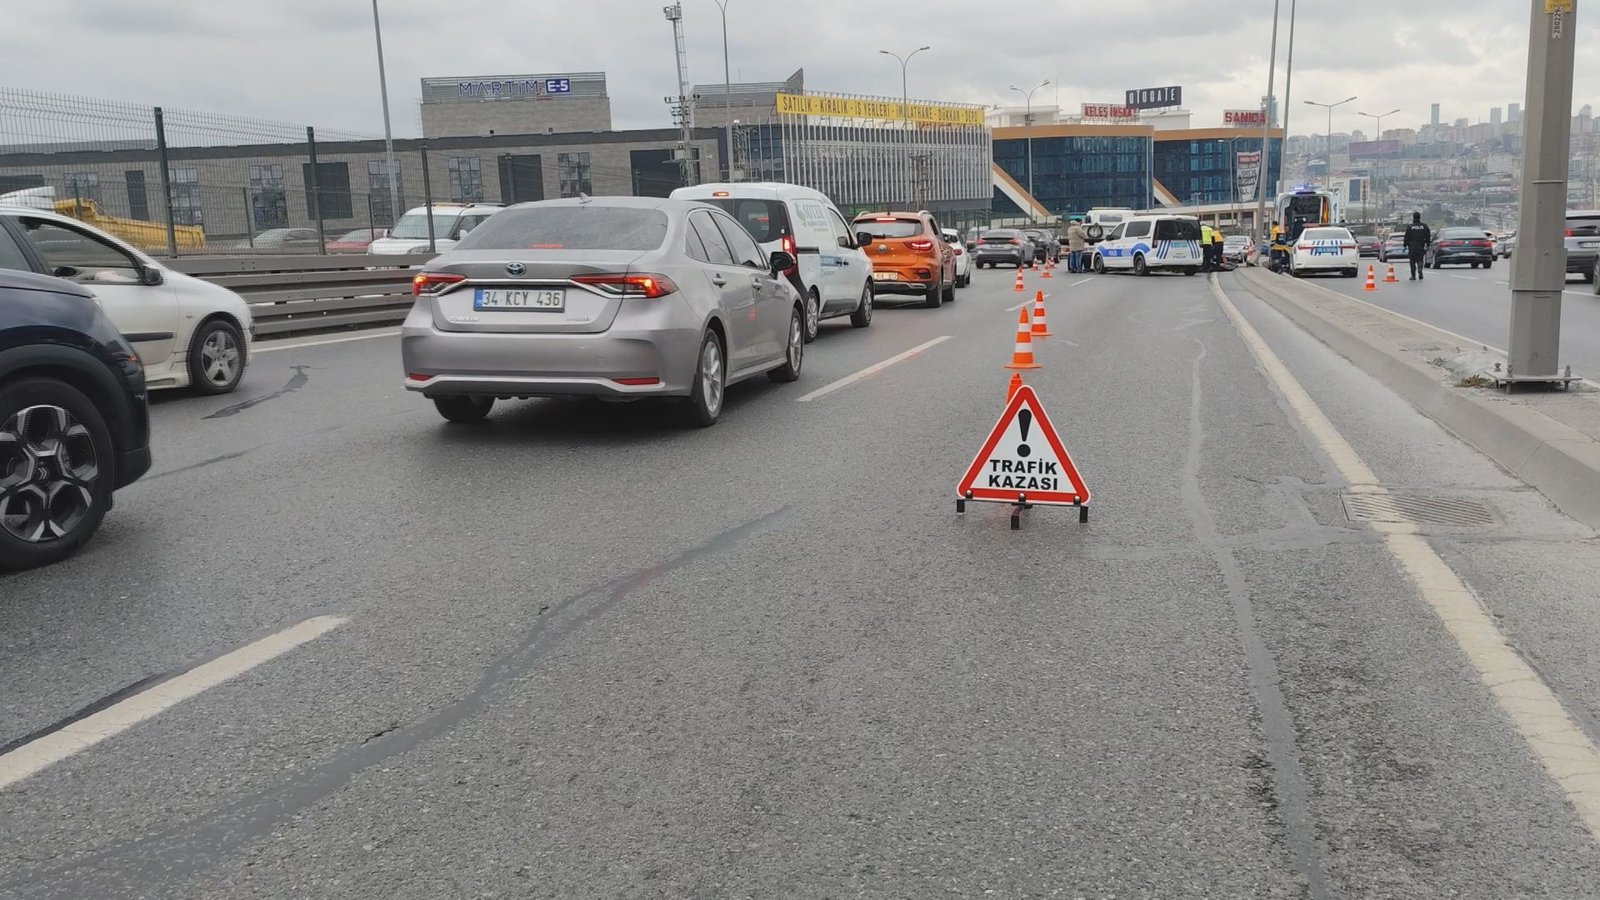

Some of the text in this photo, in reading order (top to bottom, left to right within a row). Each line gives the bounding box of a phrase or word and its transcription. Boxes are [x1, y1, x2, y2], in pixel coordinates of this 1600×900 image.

[547, 79, 569, 92] E-5
[783, 96, 812, 112] SATILIK
[820, 98, 849, 114] KİRALIK
[483, 291, 561, 306] 34 KCY 436
[989, 458, 1057, 475] TRAFİK
[988, 474, 1058, 491] KAZASI
